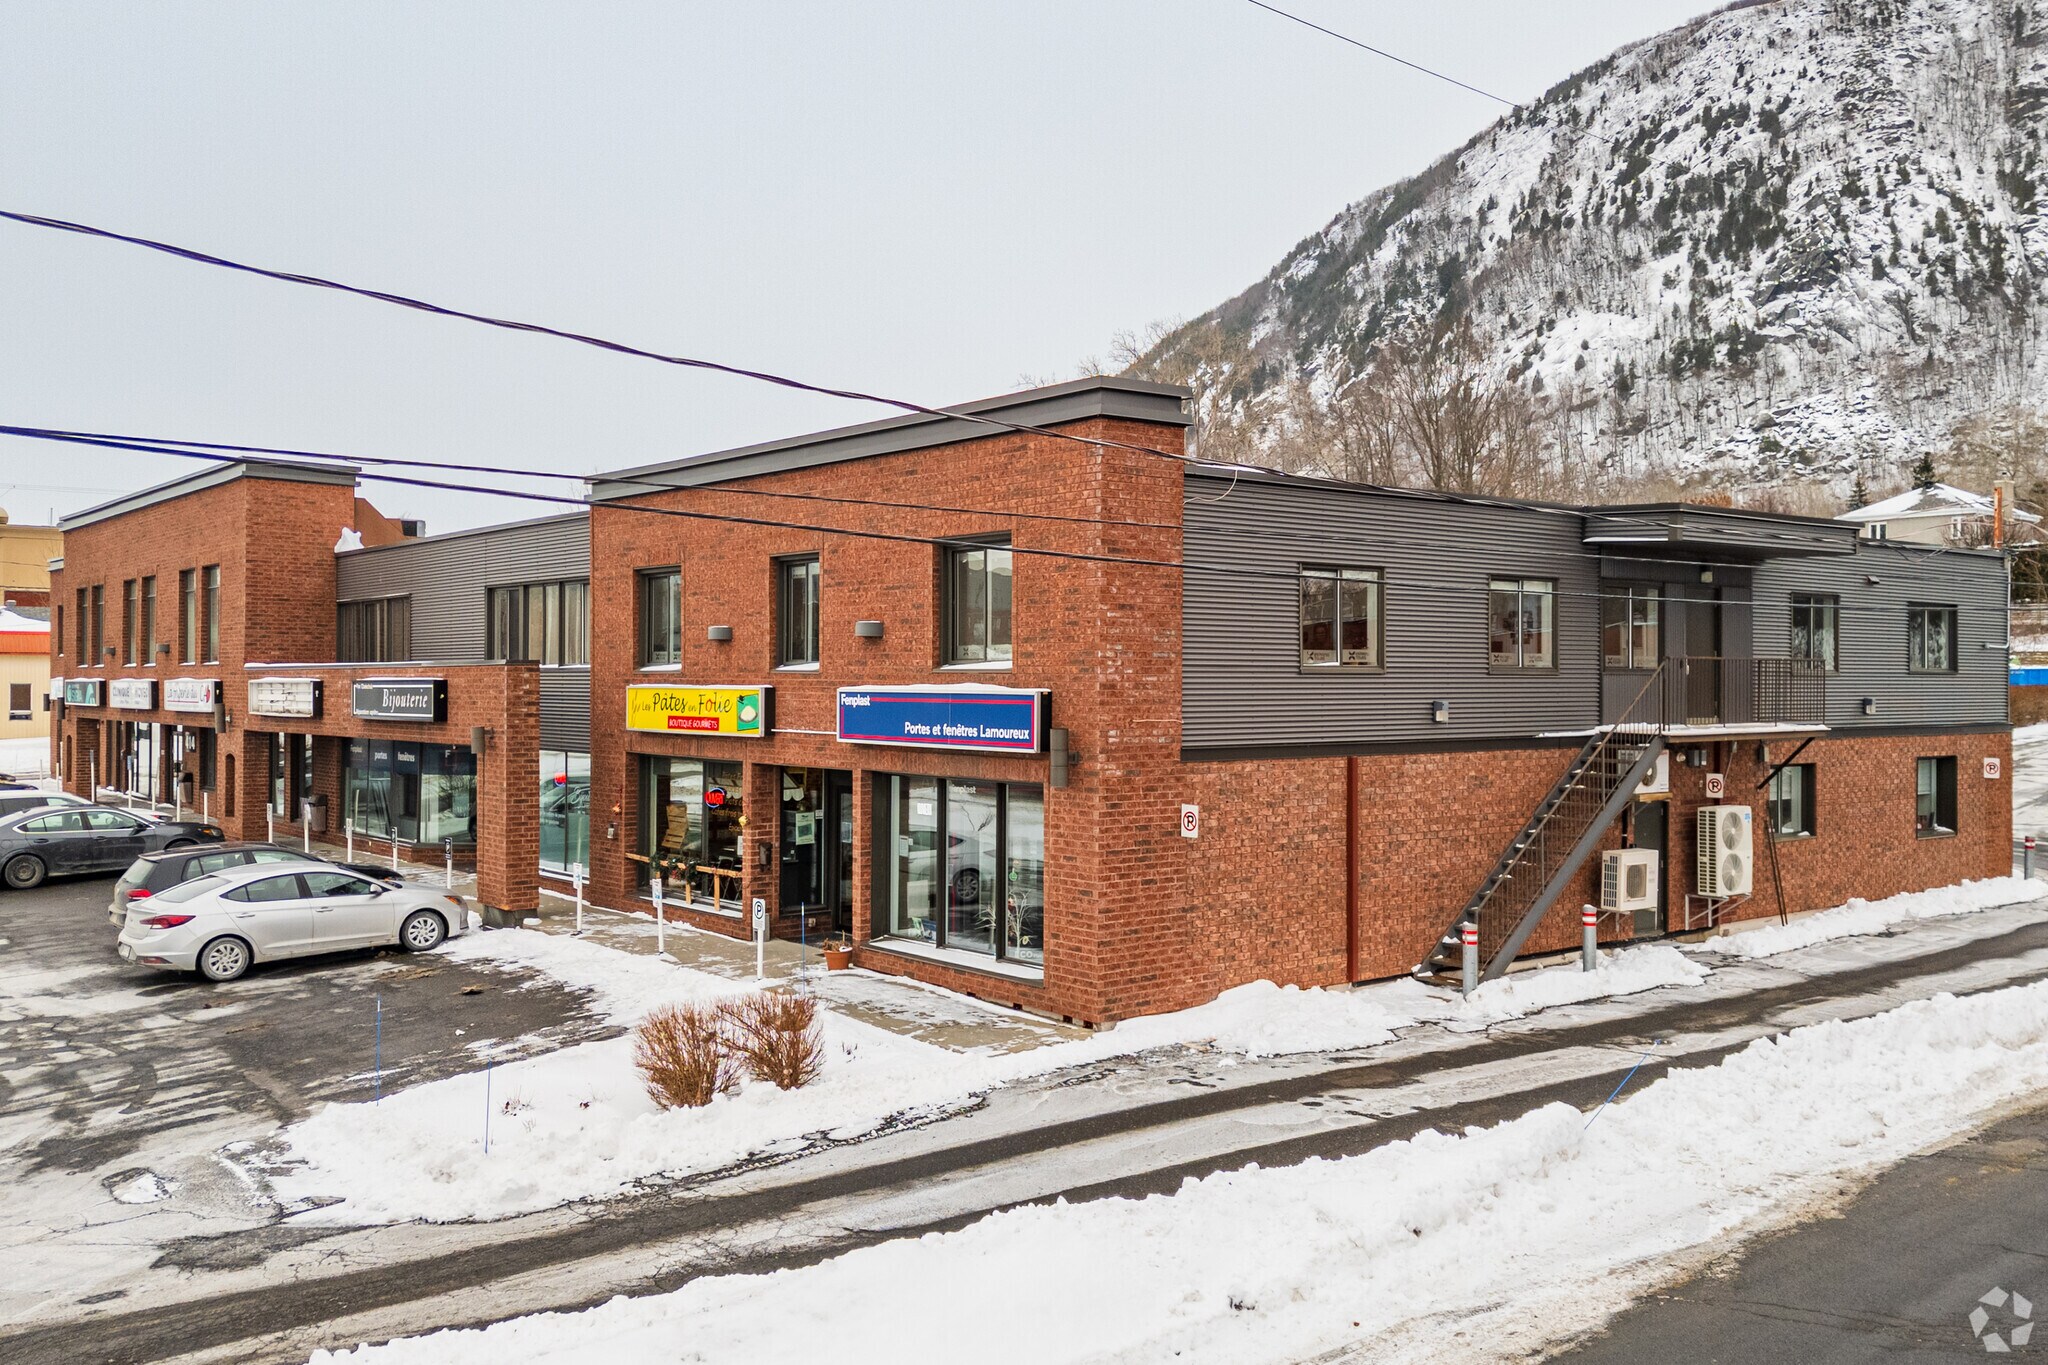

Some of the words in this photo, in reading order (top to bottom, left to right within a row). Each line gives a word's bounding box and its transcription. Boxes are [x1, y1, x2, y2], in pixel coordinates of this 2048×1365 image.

[382, 688, 428, 713] Bijouterie
[653, 692, 688, 713] Pâtes
[698, 692, 733, 715] Folie
[841, 694, 870, 708] Fenplast
[669, 719, 692, 728] BOUTIQUE
[693, 719, 718, 728] GOURMETS
[904, 722, 930, 735] Portes
[932, 724, 941, 735] et
[942, 723, 978, 737] fenêtres
[980, 725, 1030, 740] Lamoureux
[375, 752, 387, 761] portes
